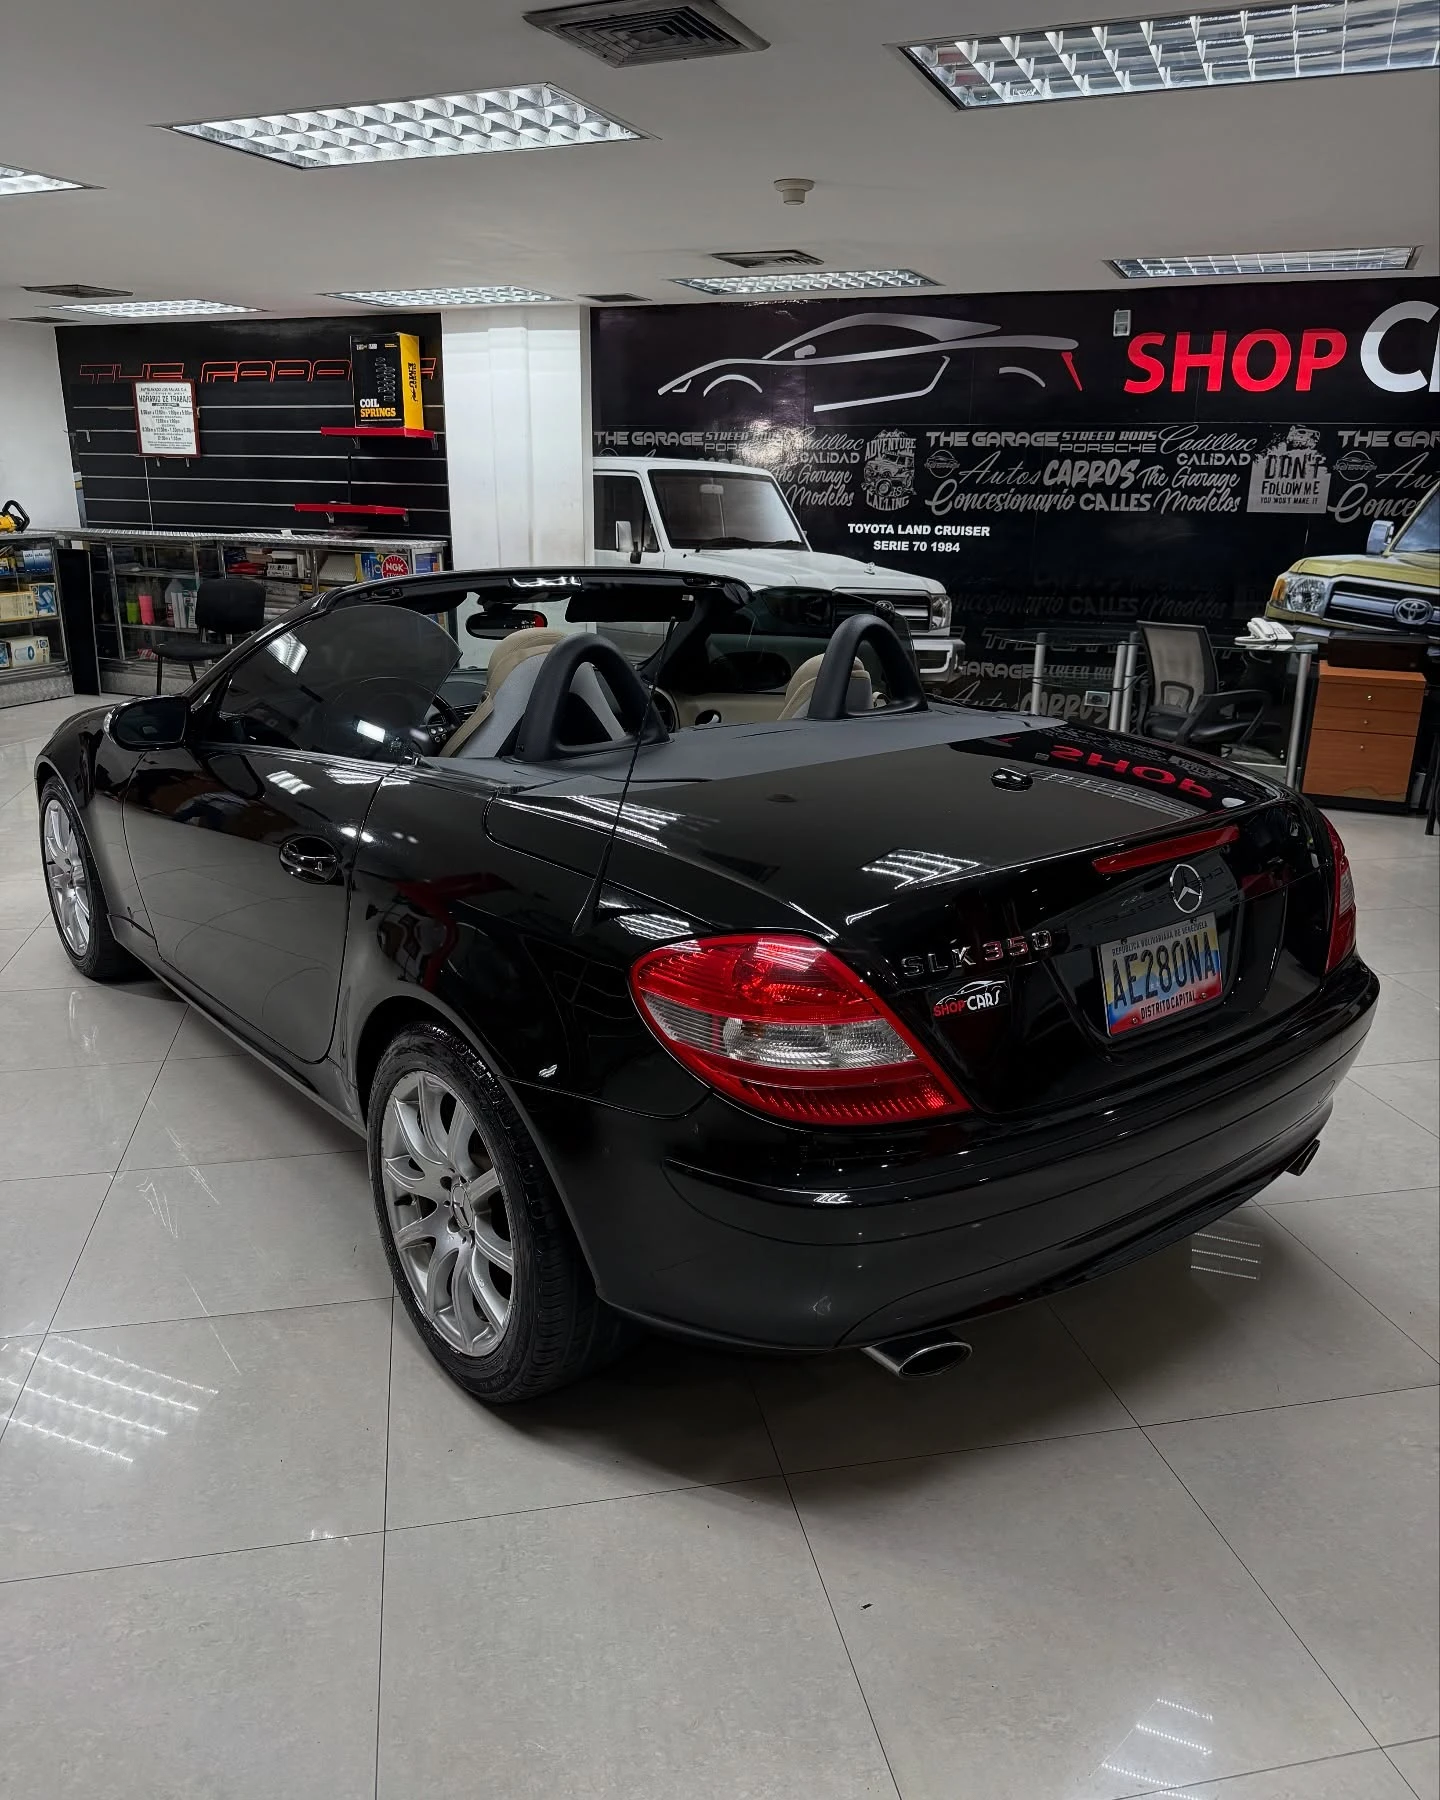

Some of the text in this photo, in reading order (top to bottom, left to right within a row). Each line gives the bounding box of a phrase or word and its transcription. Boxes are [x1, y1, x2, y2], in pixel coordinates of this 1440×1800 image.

[1124, 300, 1440, 394] SHOP C
[360, 398, 380, 408] COIL
[360, 407, 397, 418] SPRINGS
[594, 431, 705, 446] THE GARAGE
[865, 437, 917, 462] ADVENTURE
[926, 431, 1061, 448] THE GARAGE
[1059, 443, 1157, 453] PORSCHE
[1158, 424, 1258, 455] Cadillac
[1337, 430, 1392, 448] THE
[797, 463, 853, 490] Garage
[958, 450, 1042, 485] Autos
[1042, 458, 1141, 489] CARROS
[1136, 464, 1241, 494] The Garage
[1261, 480, 1320, 496] FOLLOW ME
[783, 484, 856, 508] Modelos
[924, 478, 1077, 516] Concesionario
[1079, 492, 1153, 512] CALLES
[1153, 488, 1242, 515] Modelos
[848, 523, 991, 537] TOYOTA LAND CRUISER
[873, 540, 961, 553] SERIE 70 1984
[385, 562, 404, 572] NGK
[901, 929, 1052, 977] SLK 350
[1112, 931, 1217, 1010] AE280NA
[1140, 1000, 1171, 1020] DISTRITO
